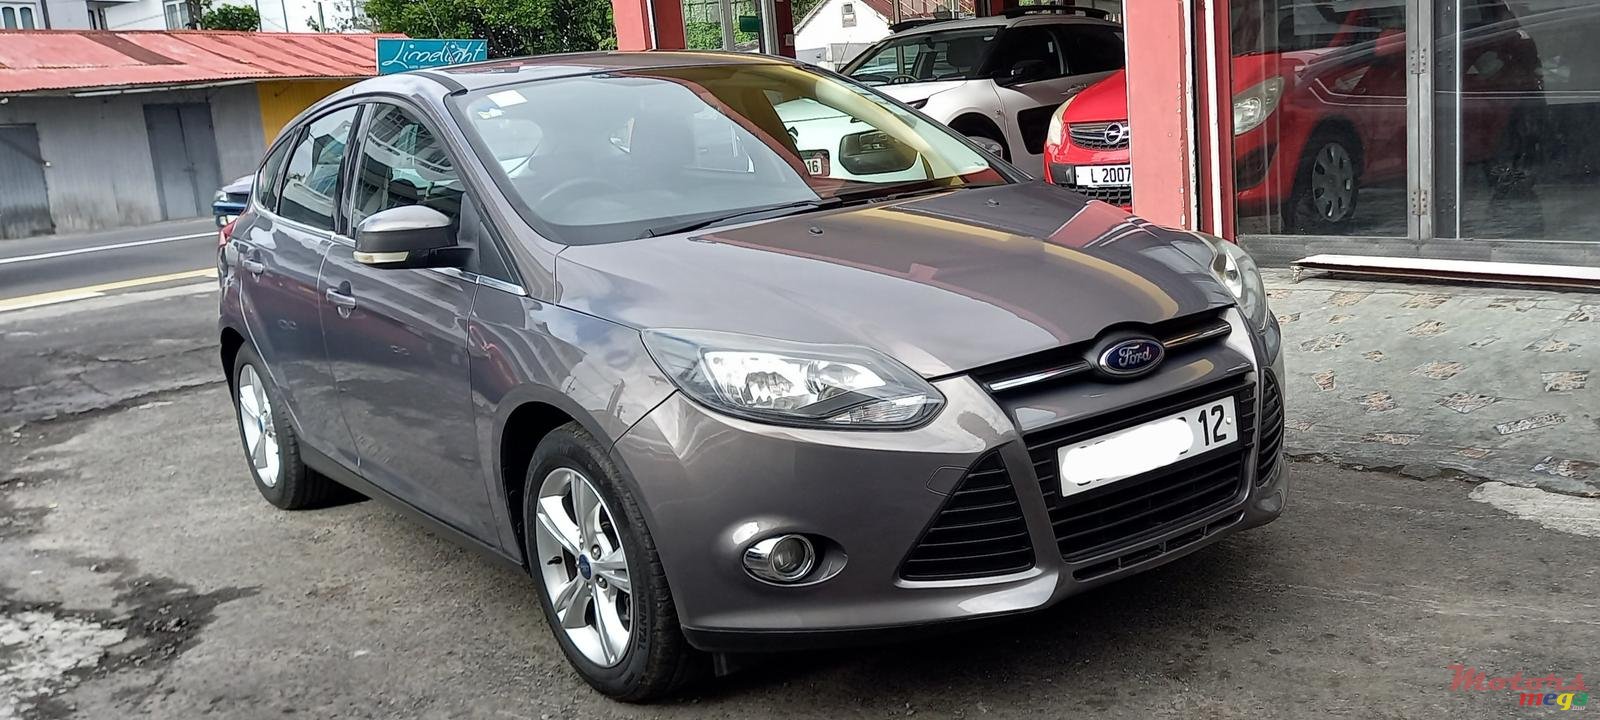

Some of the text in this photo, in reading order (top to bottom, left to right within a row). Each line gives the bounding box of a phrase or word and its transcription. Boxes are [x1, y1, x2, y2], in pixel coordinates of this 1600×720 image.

[381, 41, 484, 69] Limelight
[807, 160, 819, 173] 16
[1090, 167, 1131, 183] L 2007
[1118, 344, 1152, 367] Ford
[1198, 404, 1227, 446] 12
